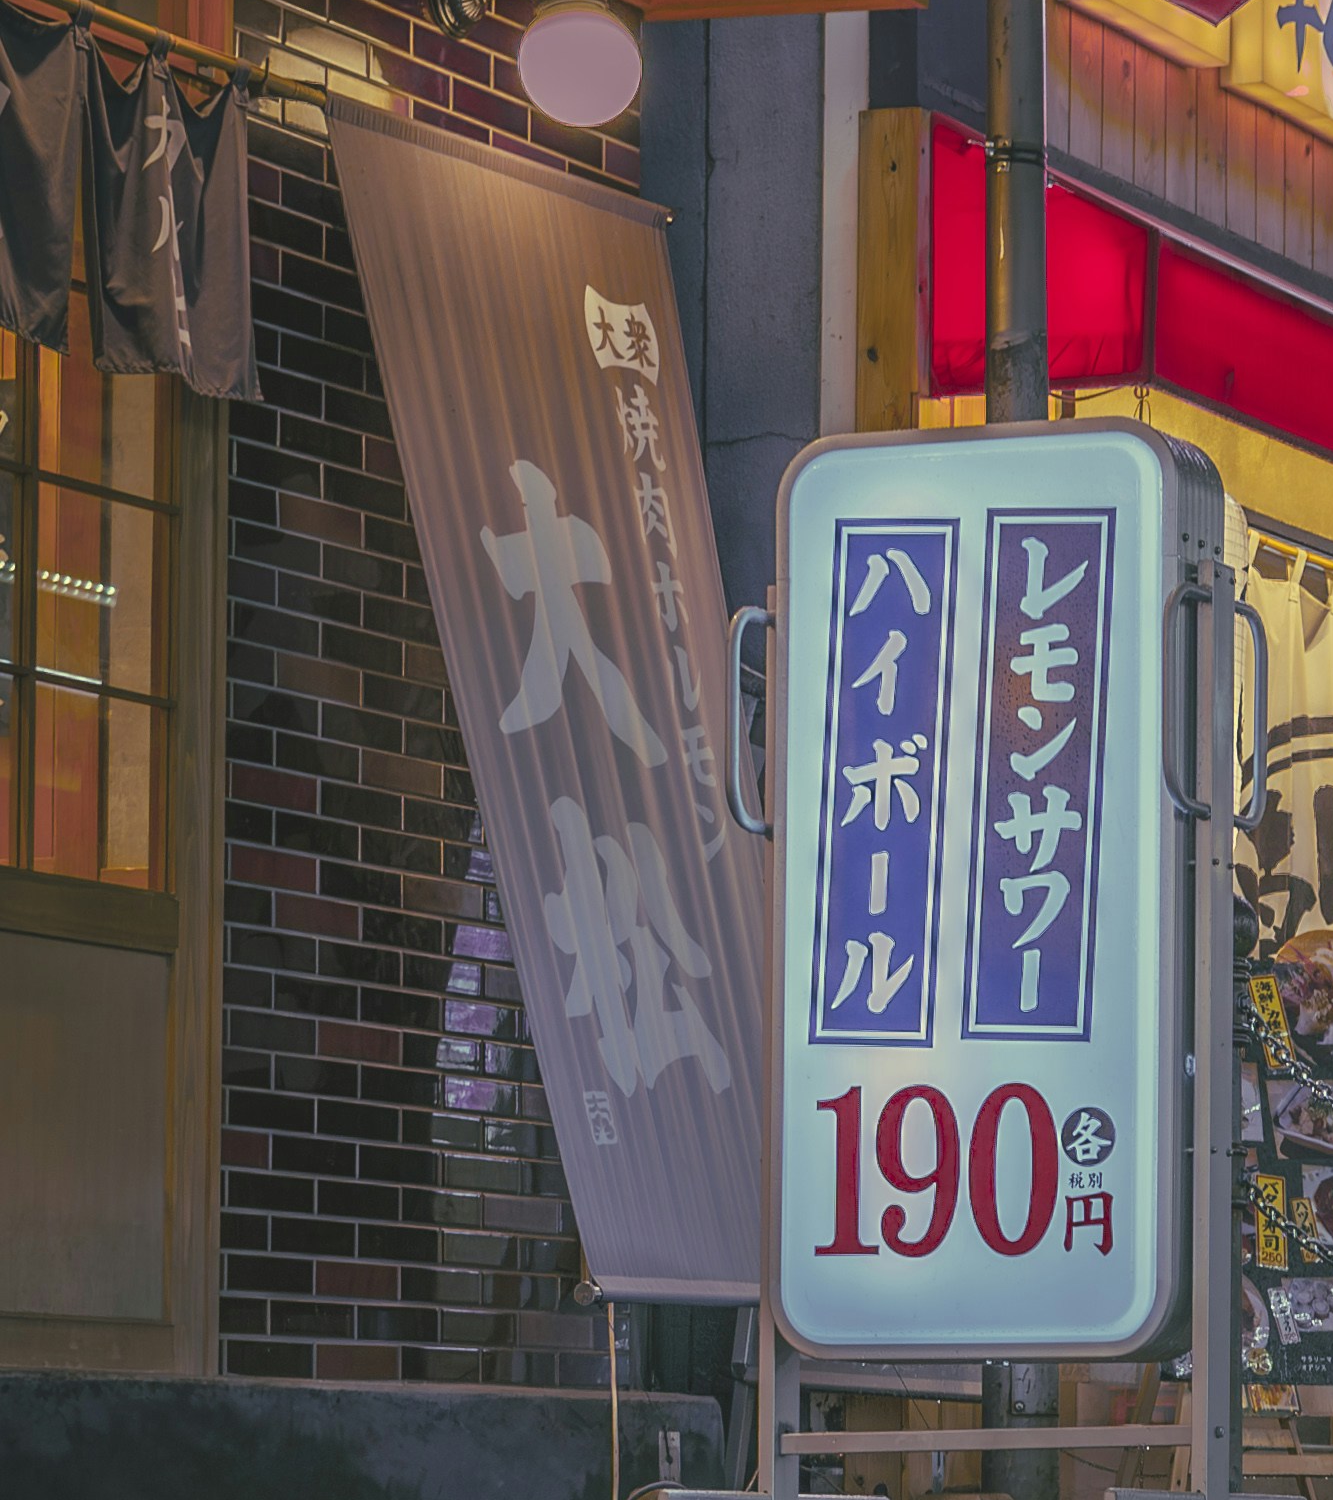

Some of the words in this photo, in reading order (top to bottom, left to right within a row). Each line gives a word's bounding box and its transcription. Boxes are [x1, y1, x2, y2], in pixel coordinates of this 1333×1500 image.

[591, 305, 658, 370] 大衆
[481, 459, 732, 1098] 大松
[616, 384, 725, 869] 焼肉ホルモン
[830, 545, 934, 1017] ハイボール
[993, 535, 1090, 1013] レモンサワー
[1067, 1170, 1104, 1189] 税別
[1069, 1111, 1112, 1164] 各
